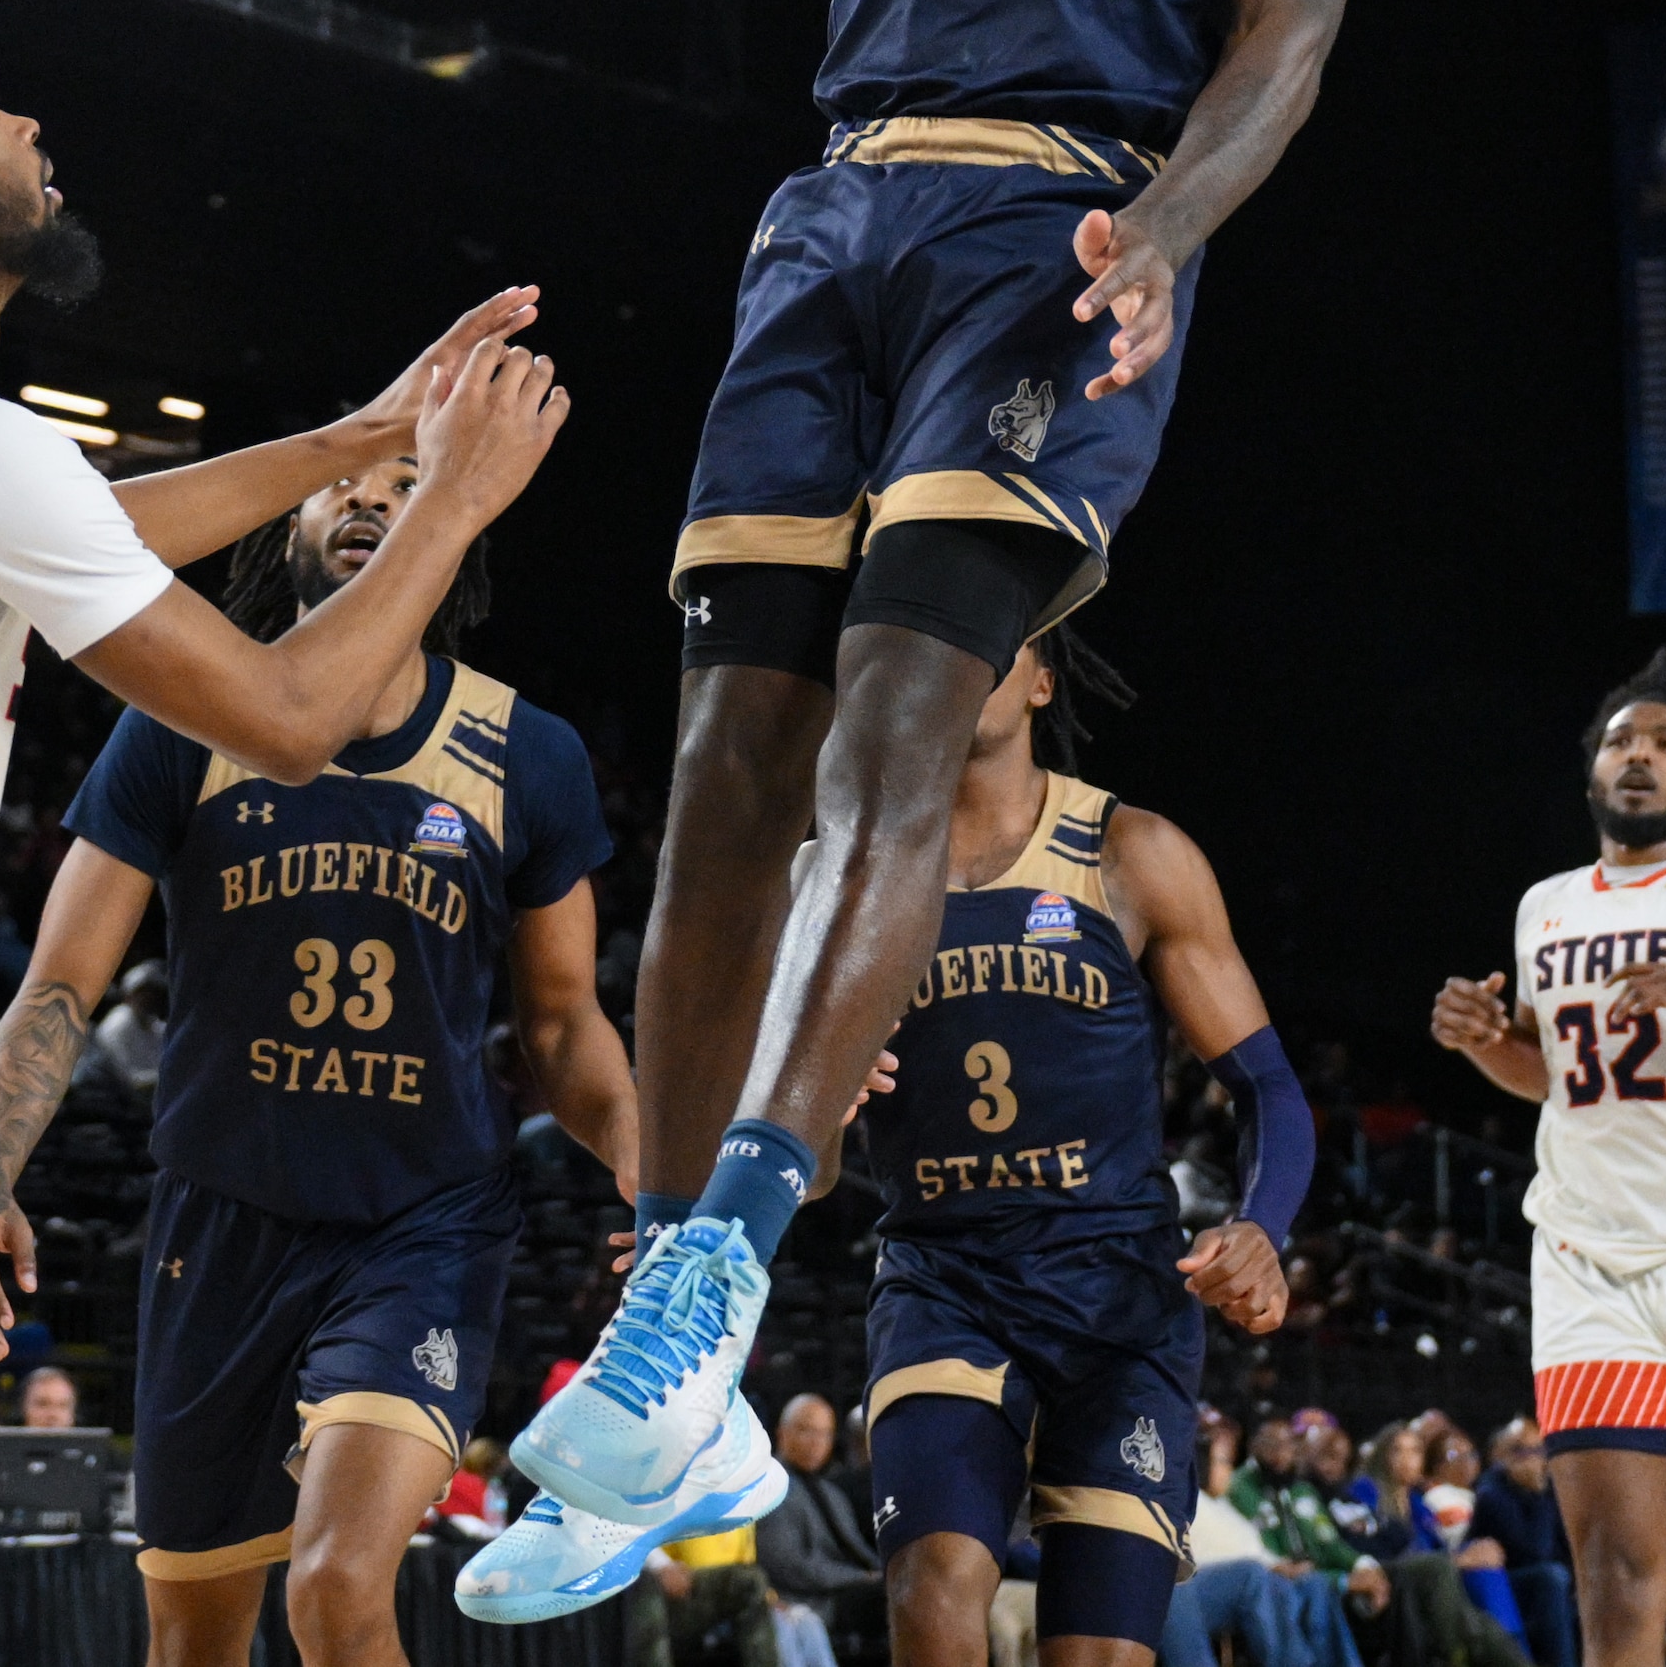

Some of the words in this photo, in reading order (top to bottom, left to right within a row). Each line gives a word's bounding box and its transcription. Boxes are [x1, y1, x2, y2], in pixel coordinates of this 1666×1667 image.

[419, 824, 464, 841] CIAA
[221, 841, 469, 936] BLUEFIELD
[1029, 911, 1073, 927] CIAA
[289, 937, 398, 1032] 33
[911, 943, 1110, 1010] UEFIELD
[250, 1037, 426, 1106] STATE
[963, 1040, 1019, 1134] 3
[915, 1138, 1090, 1202] STATE
